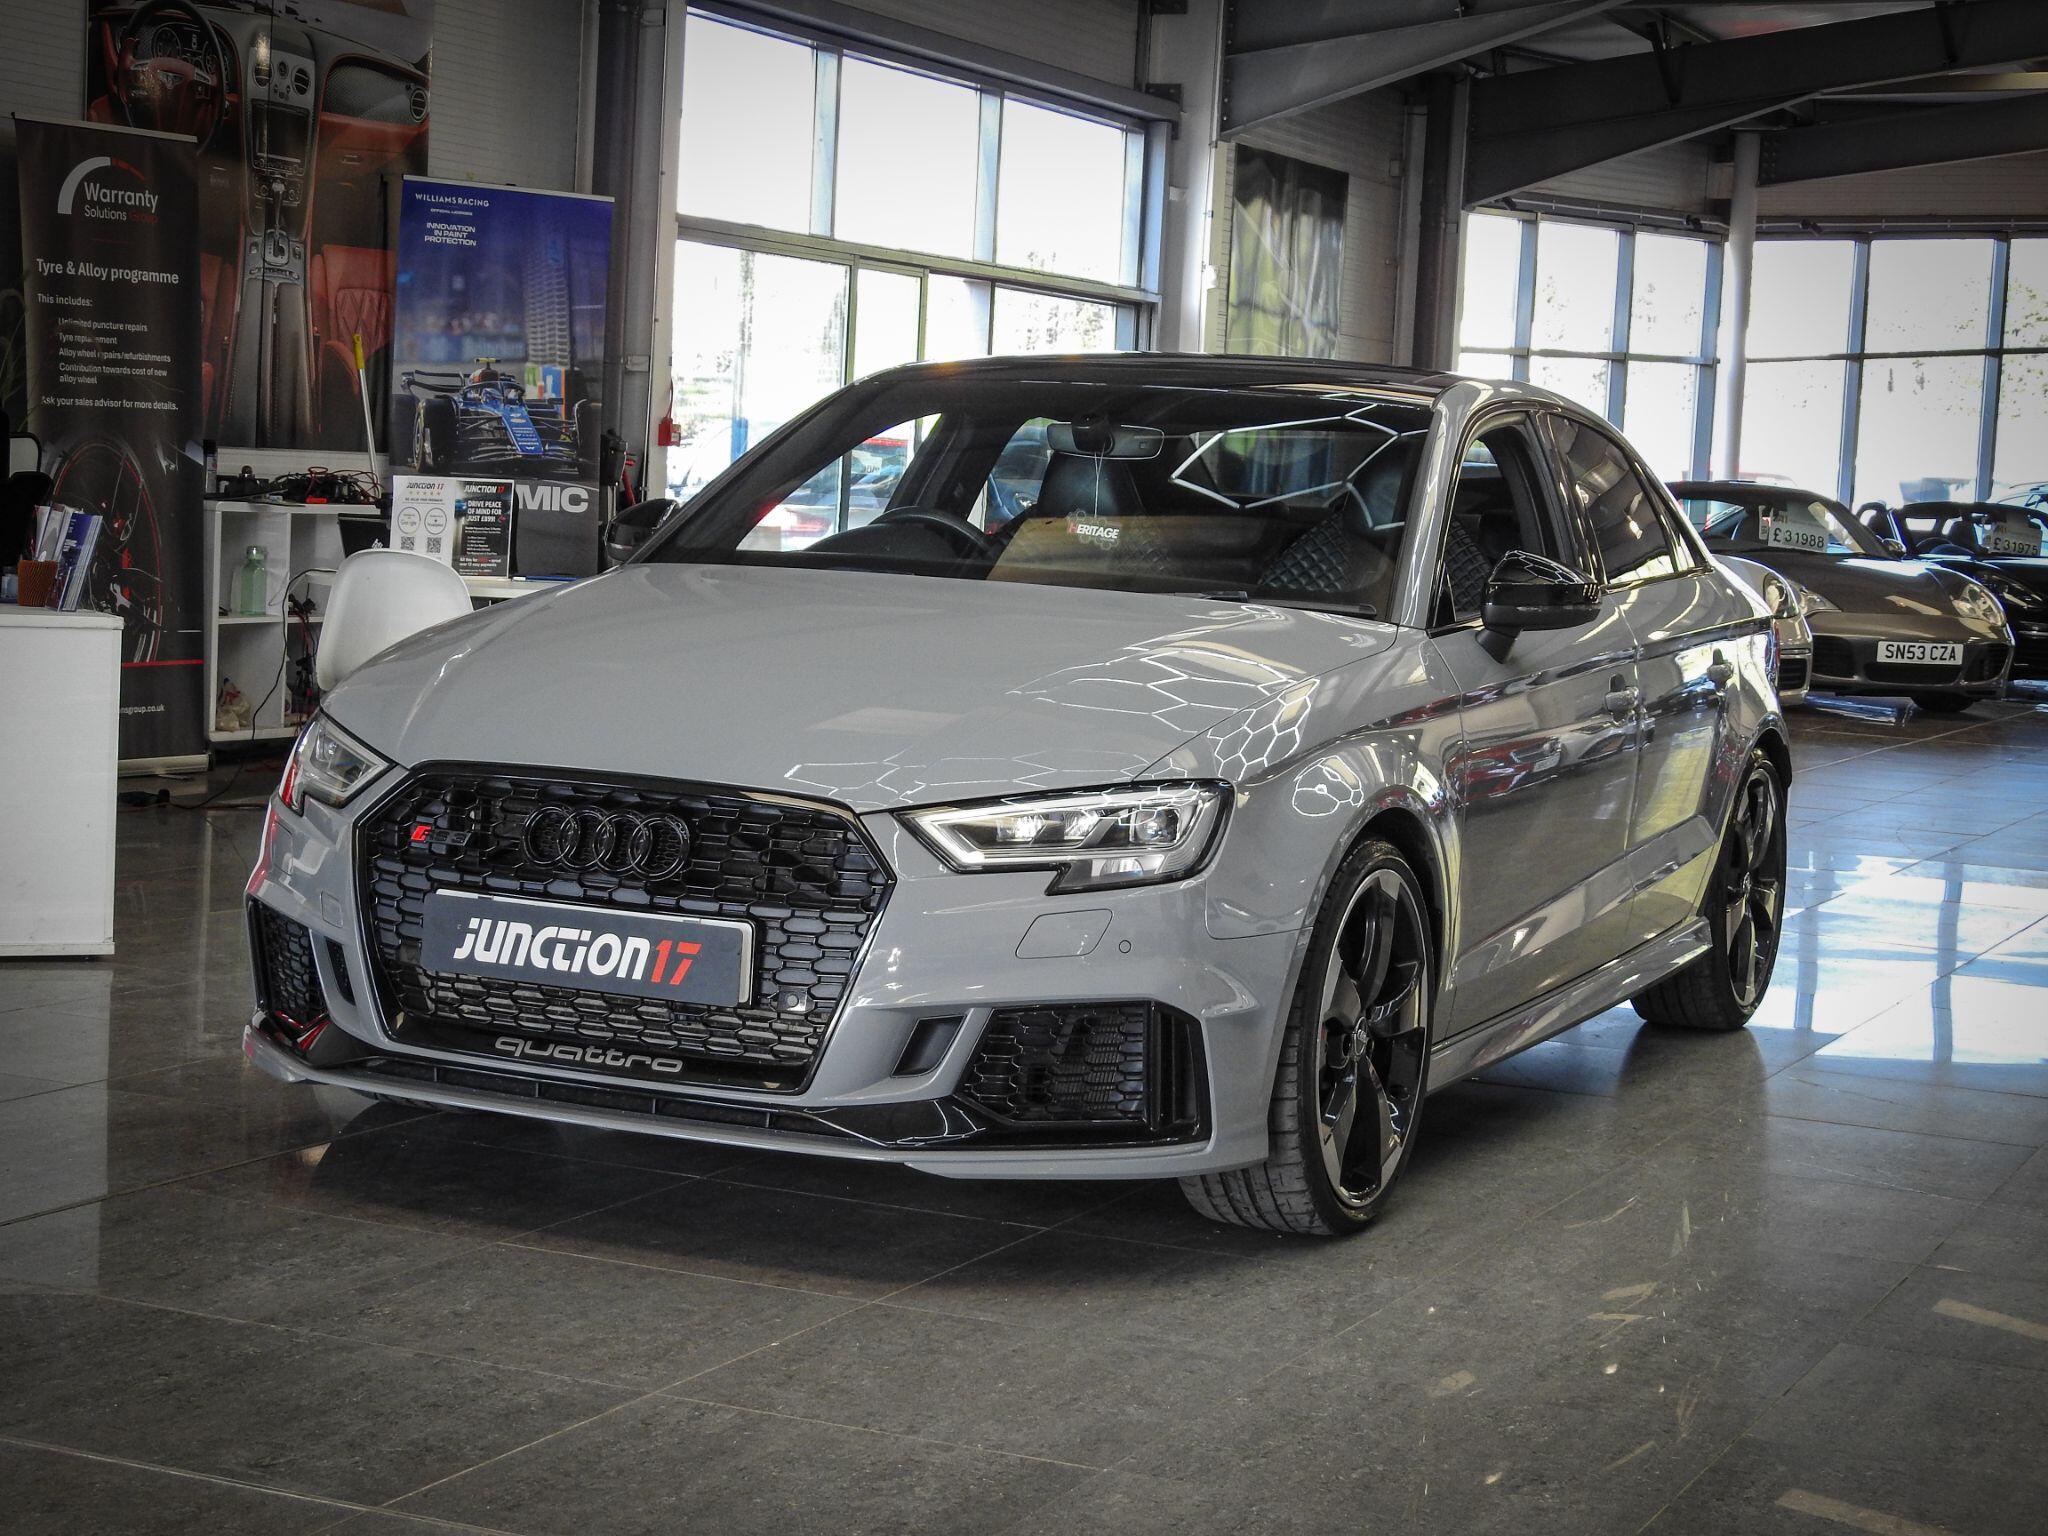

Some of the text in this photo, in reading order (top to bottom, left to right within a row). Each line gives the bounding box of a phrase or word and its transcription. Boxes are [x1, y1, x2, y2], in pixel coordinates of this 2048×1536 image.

[84, 181, 159, 214] Warranty
[415, 193, 490, 207] WILLIAMS RACING
[84, 204, 127, 221] Solutions
[426, 222, 476, 232] INNOVATION
[444, 230, 468, 238] PAINT
[424, 236, 476, 246] PROTECTION
[36, 258, 179, 284] Tyre & Alloy programme
[38, 293, 93, 307] This includes:
[92, 320, 124, 331] puncture
[125, 322, 148, 332] repairs
[58, 333, 74, 344] Tyre
[58, 347, 76, 358] Alloy
[77, 349, 96, 358] wheel
[102, 366, 131, 375] towards
[132, 368, 146, 376] cost
[146, 368, 154, 376] of
[59, 374, 98, 384] alloy wheel
[56, 397, 74, 406] your
[74, 397, 94, 406] sales
[94, 398, 121, 408] advisor
[122, 399, 134, 408] for
[134, 400, 152, 409] more
[464, 484, 497, 494] JUNCTION
[468, 500, 484, 508] DRIVE
[1069, 522, 1120, 539] HERITAGE
[1773, 528, 1825, 548] £31988
[1885, 644, 1956, 661] SN53 CZA
[494, 1036, 684, 1072] quattro
